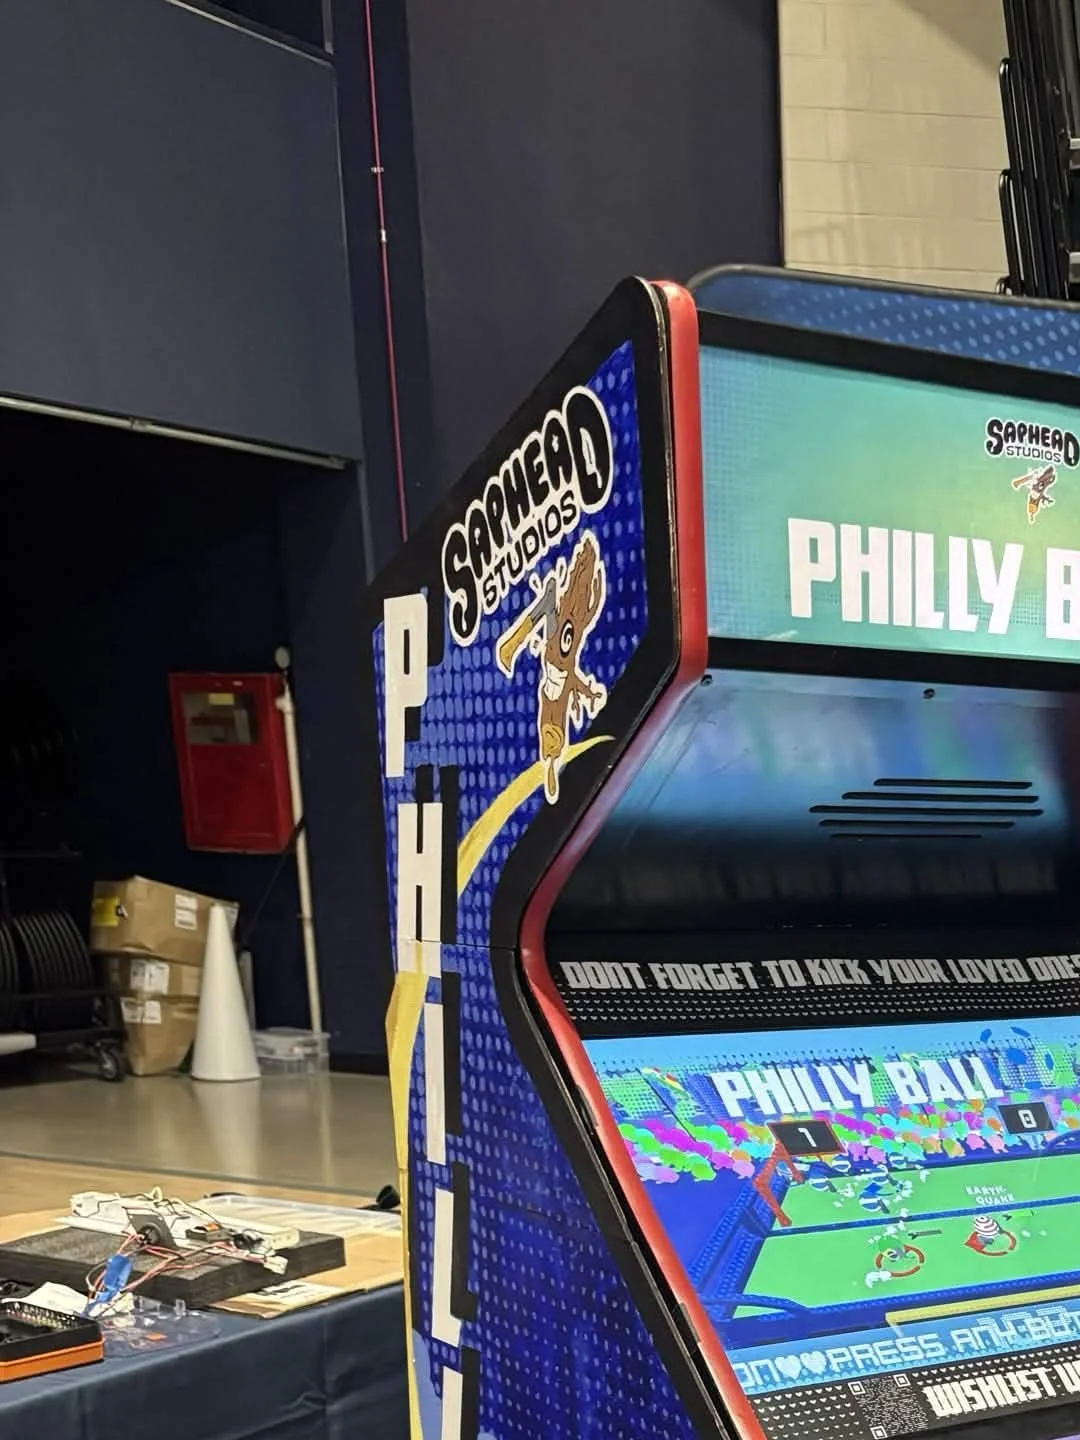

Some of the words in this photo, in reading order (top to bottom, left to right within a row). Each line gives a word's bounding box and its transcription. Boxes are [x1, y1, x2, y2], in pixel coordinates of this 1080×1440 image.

[985, 418, 1080, 468] SAPHEAD
[1006, 445, 1062, 463] STUDIOS
[444, 390, 612, 640] SAPHEAD
[482, 489, 579, 609] STUDIOS
[787, 518, 1024, 635] PHILLY
[559, 961, 647, 990] DONT
[648, 961, 760, 991] FORGET
[761, 959, 808, 988] TO
[804, 958, 872, 986] KICK
[867, 958, 950, 985] YOUR
[946, 957, 1032, 984] LOVED
[710, 1061, 875, 1118] PHILLY
[884, 1053, 1005, 1106] BALL
[797, 1126, 817, 1149] 1
[827, 1332, 946, 1373] PRESS
[922, 1367, 1057, 1418] WISHLIST
